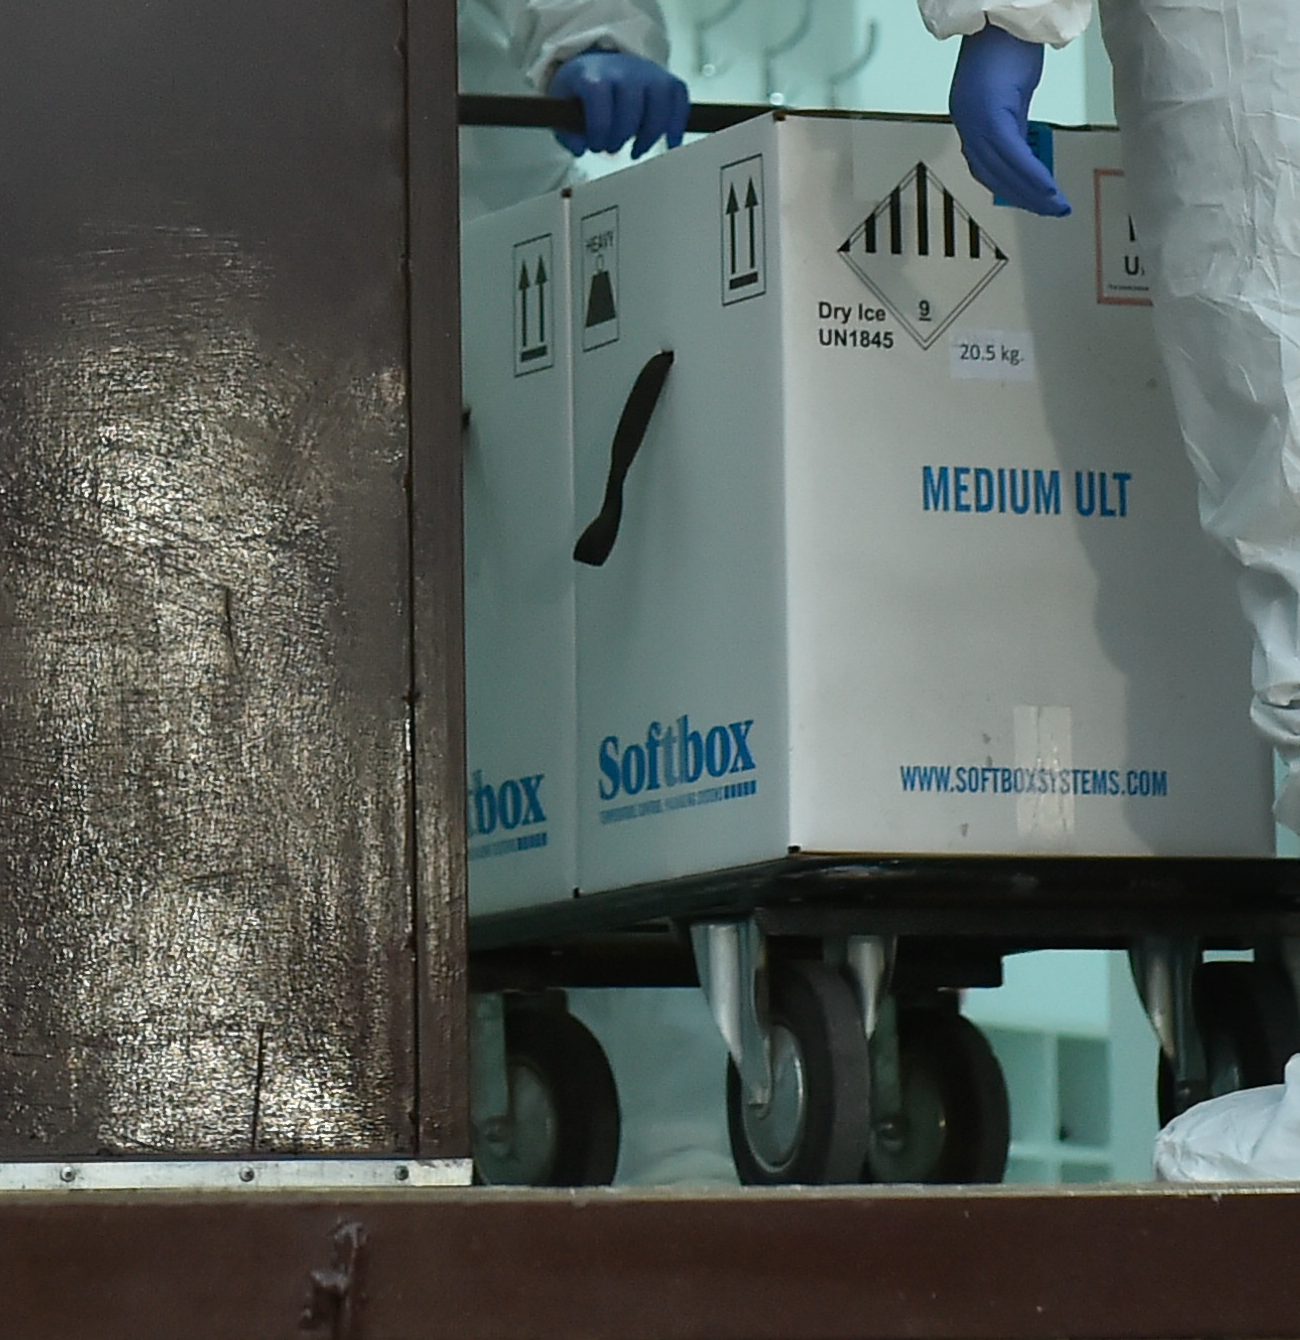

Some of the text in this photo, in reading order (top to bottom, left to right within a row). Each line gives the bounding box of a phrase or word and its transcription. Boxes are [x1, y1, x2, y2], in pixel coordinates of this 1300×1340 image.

[818, 301, 887, 324] Dry Ice
[918, 299, 931, 318] 9
[818, 328, 894, 349] UN1845
[959, 343, 996, 361] 20.5
[922, 465, 1132, 518] MEDIUM ULT
[598, 714, 757, 801] Softbox
[899, 764, 1169, 797] WWW.SOFTBOXSYSTEMS.COM
